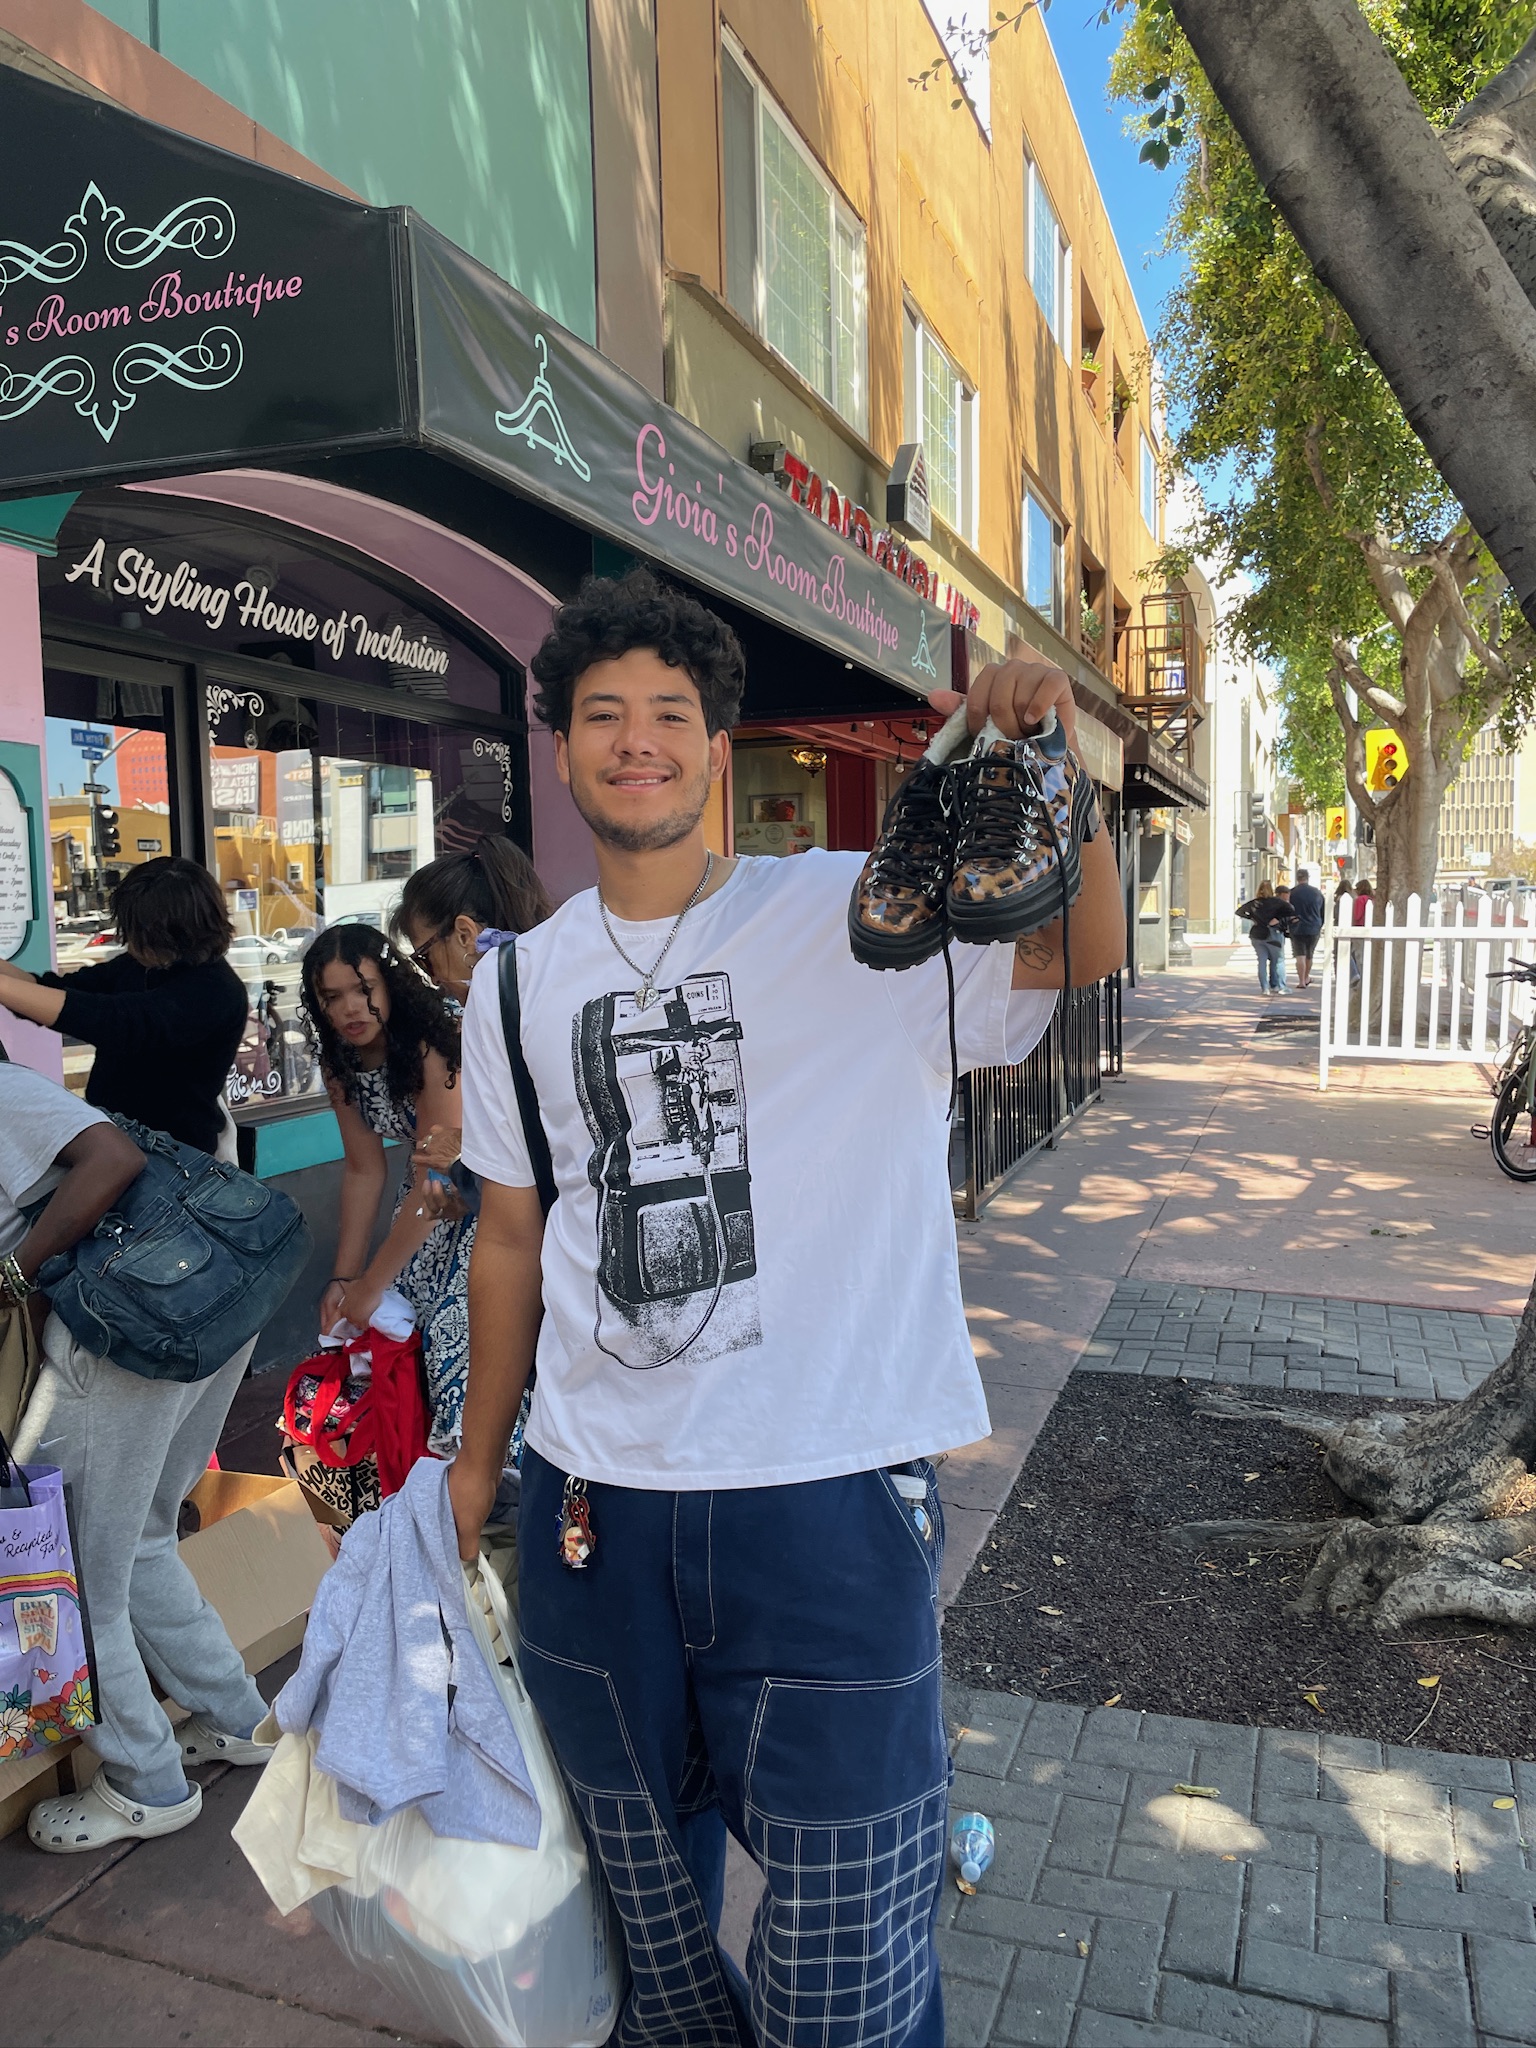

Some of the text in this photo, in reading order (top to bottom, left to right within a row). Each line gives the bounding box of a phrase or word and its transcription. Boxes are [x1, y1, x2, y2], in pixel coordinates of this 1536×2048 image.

[26, 294, 132, 342] Room
[138, 270, 303, 322] Boutique
[744, 503, 818, 602] Room
[821, 553, 899, 659] Boutique
[65, 537, 450, 676] A Styling House of Inclusion
[686, 990, 704, 1000] COINS
[4, 1523, 52, 1557] Recycled
[20, 1599, 53, 1611] BUY
[21, 1608, 54, 1619] SELL
